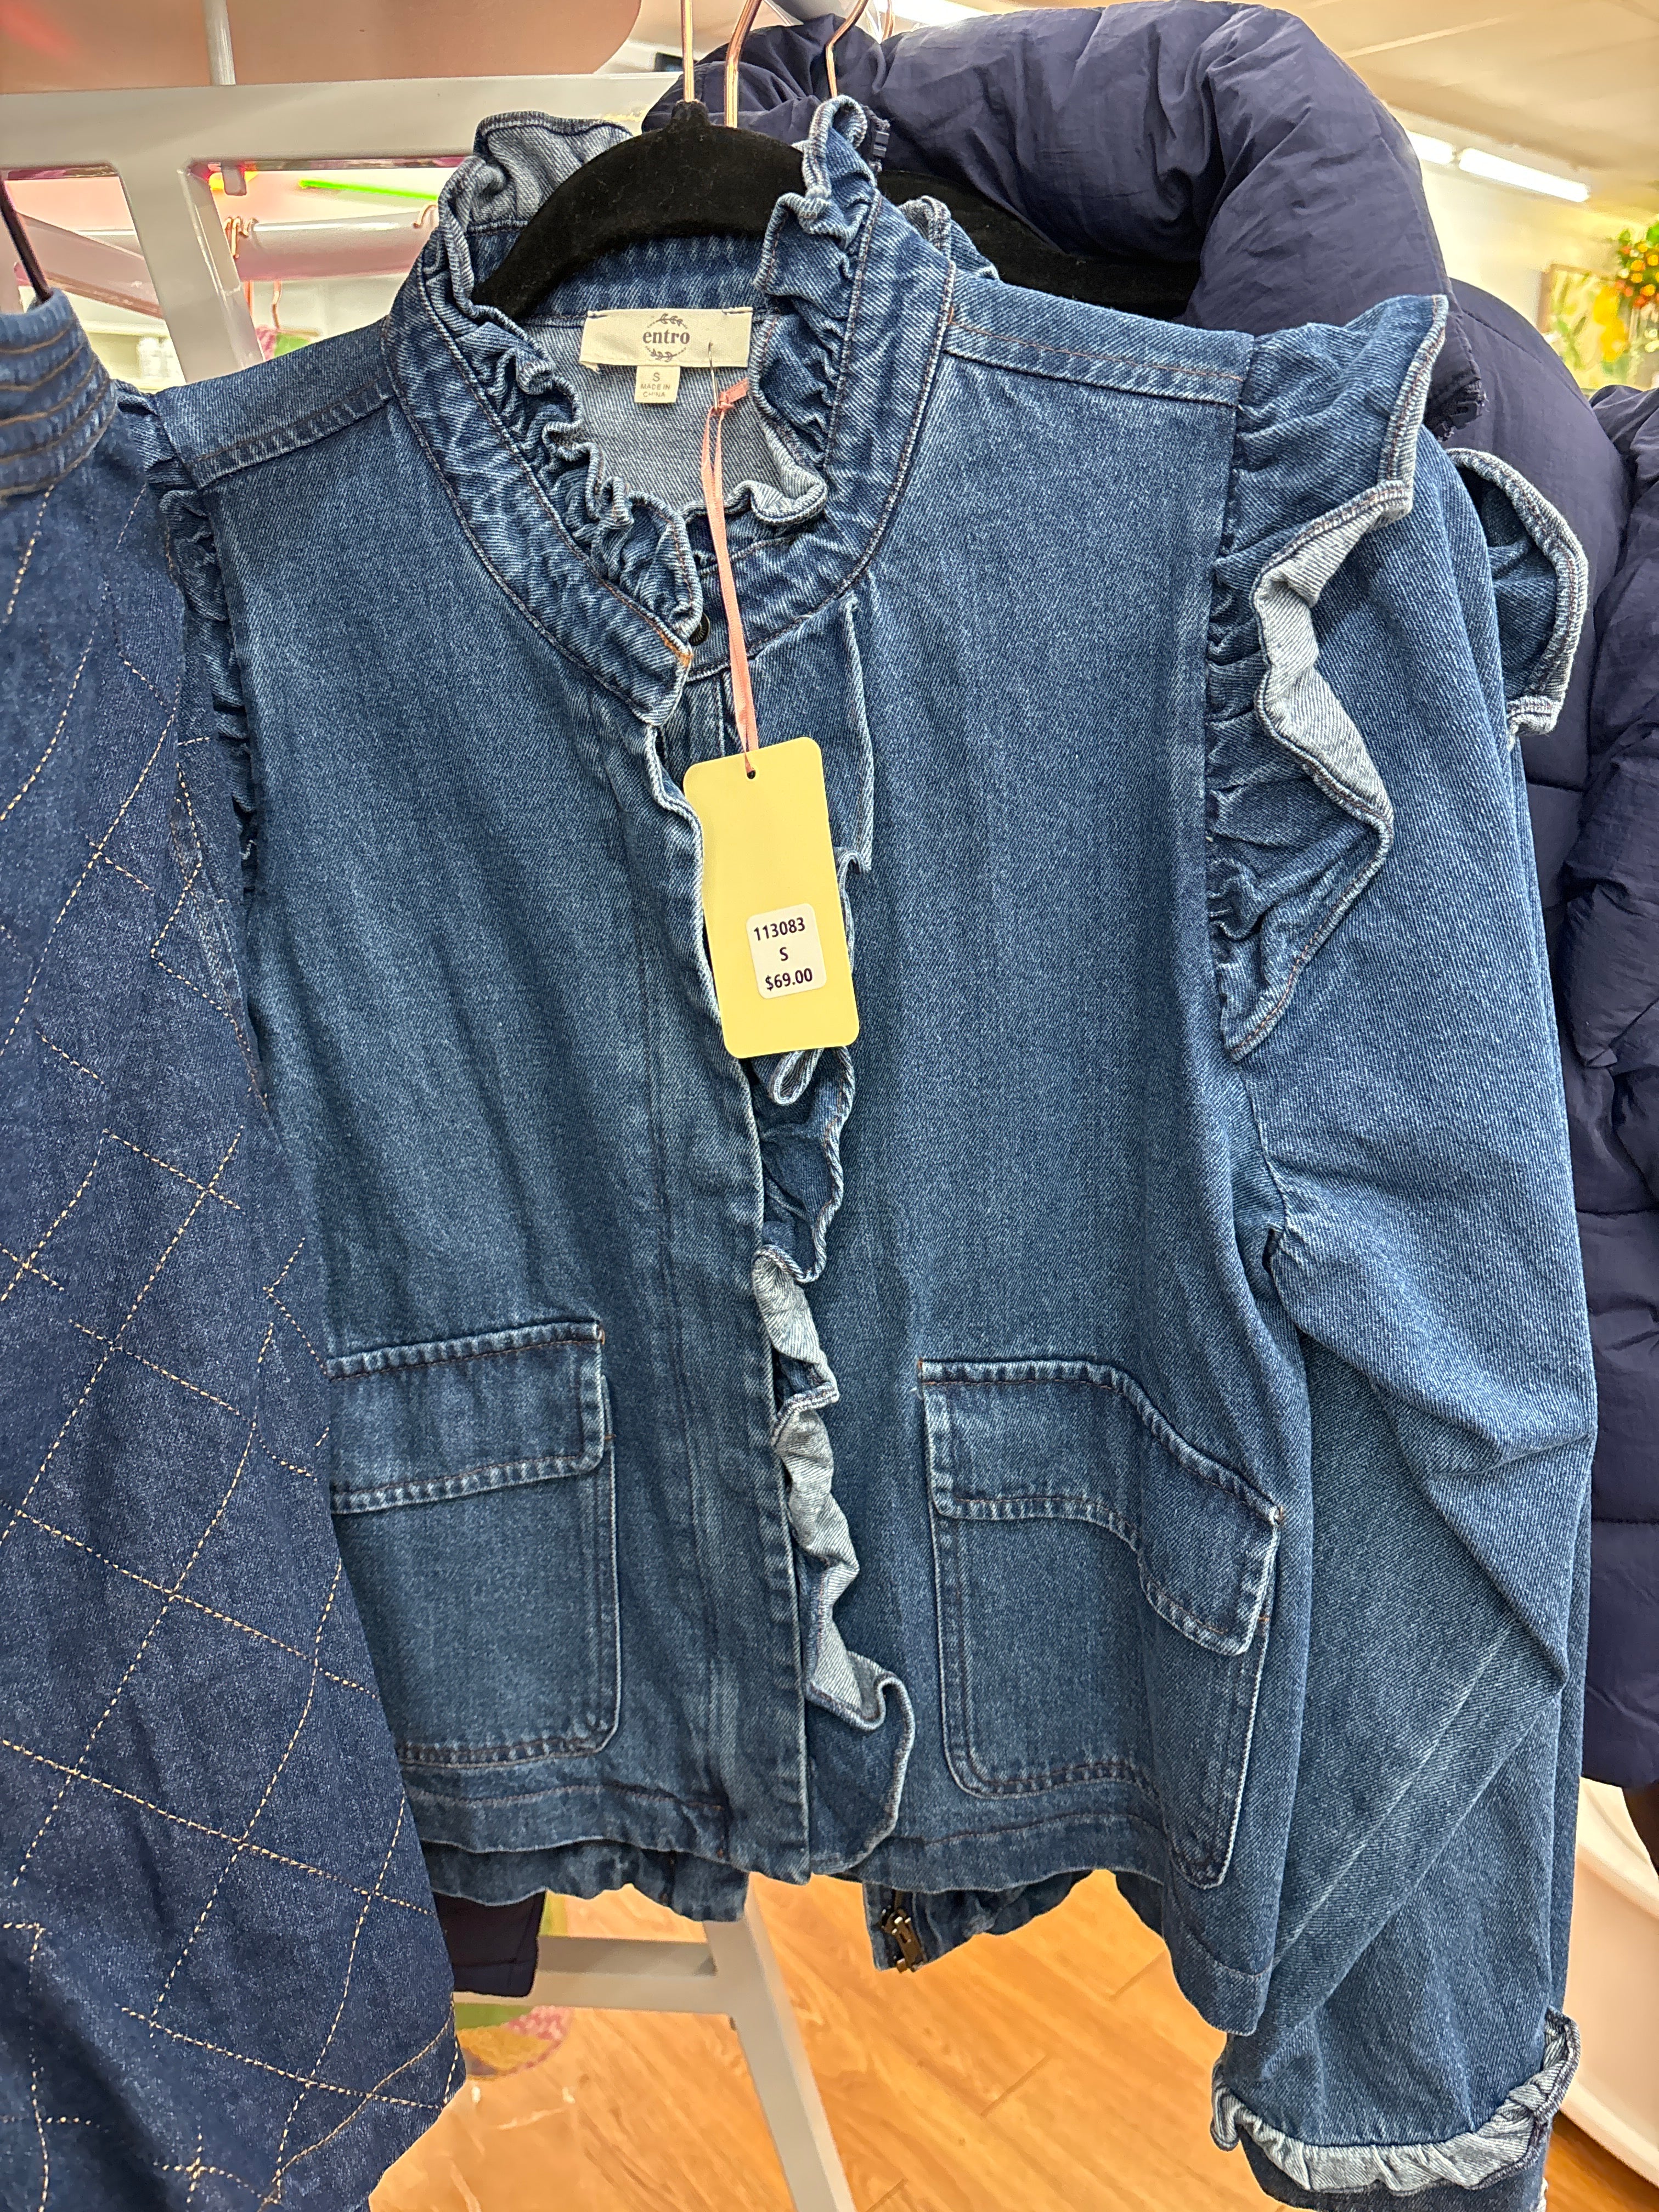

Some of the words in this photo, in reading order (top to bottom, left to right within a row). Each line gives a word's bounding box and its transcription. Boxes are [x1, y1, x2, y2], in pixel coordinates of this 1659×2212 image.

[642, 329, 690, 344] entro
[652, 372, 661, 382] S
[753, 917, 805, 941] 113083
[779, 946, 789, 961] S
[765, 968, 812, 991] $69.00
